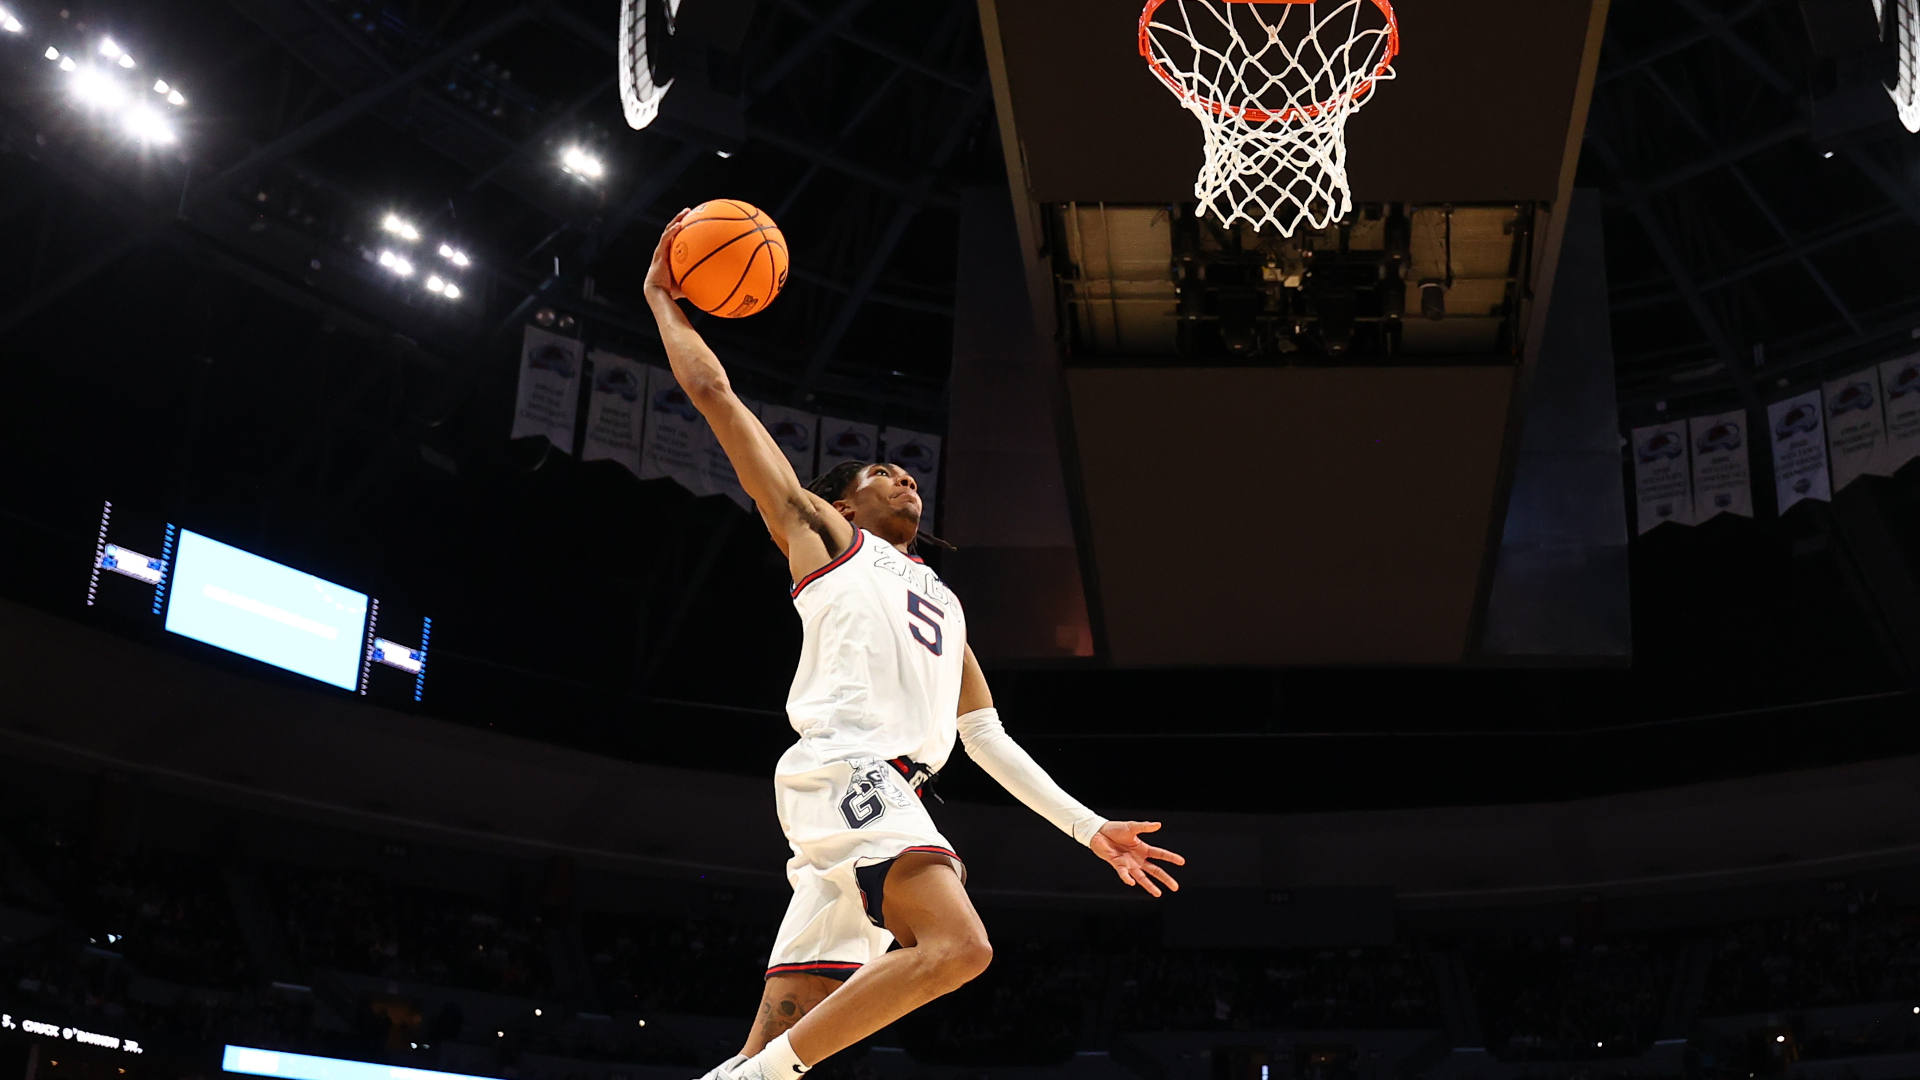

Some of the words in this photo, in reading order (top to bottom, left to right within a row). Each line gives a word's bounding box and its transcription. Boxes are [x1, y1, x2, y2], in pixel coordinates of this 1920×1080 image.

[906, 588, 945, 657] 5
[838, 779, 886, 829] G
[21, 1019, 60, 1038] CHUCK
